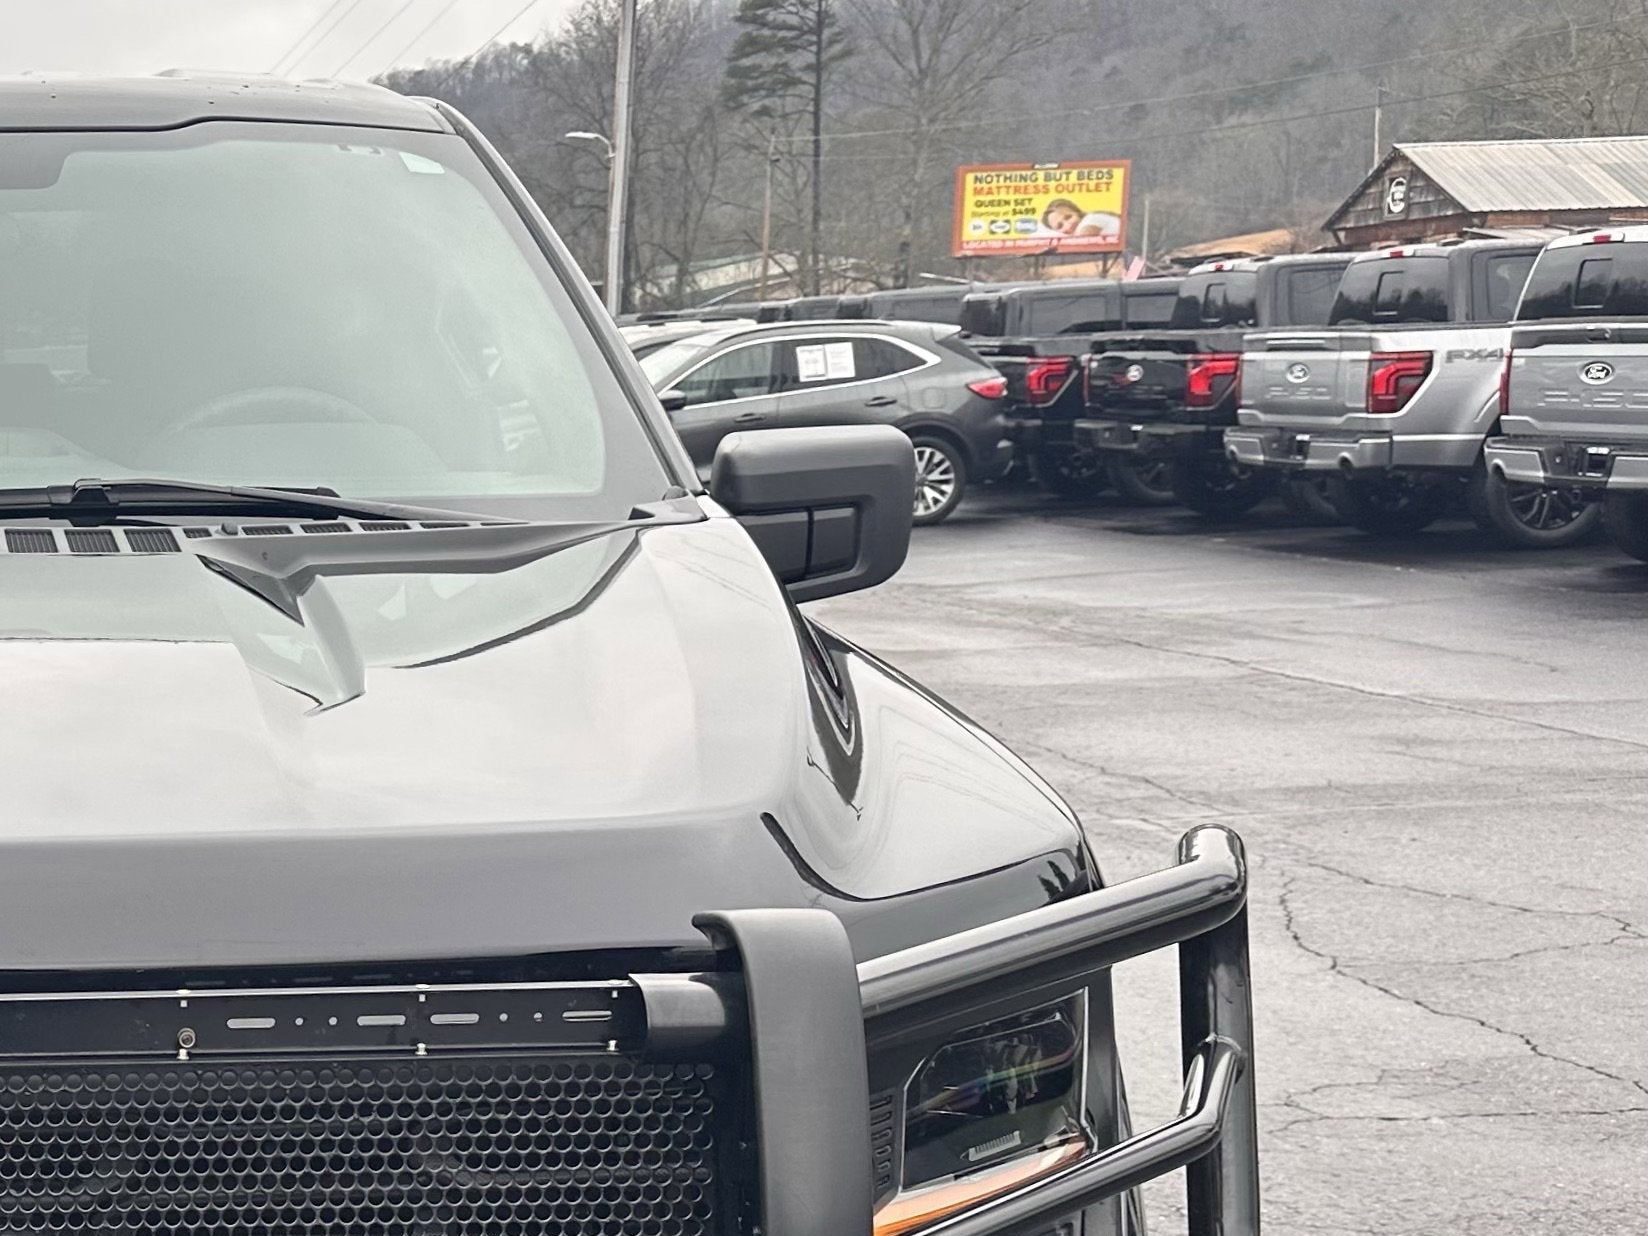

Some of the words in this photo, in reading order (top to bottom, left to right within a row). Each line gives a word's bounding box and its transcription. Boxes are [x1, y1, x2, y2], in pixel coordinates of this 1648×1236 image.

[973, 172, 1039, 185] NOTHING
[1044, 170, 1072, 182] BUT
[1076, 169, 1114, 181] BEDS
[973, 184, 1050, 196] MATTRESS
[1055, 182, 1112, 193] OUTLET
[974, 199, 1011, 208] QUEEN
[1013, 198, 1033, 206] SET
[1012, 207, 1037, 216] $499
[1445, 348, 1504, 363] FX4
